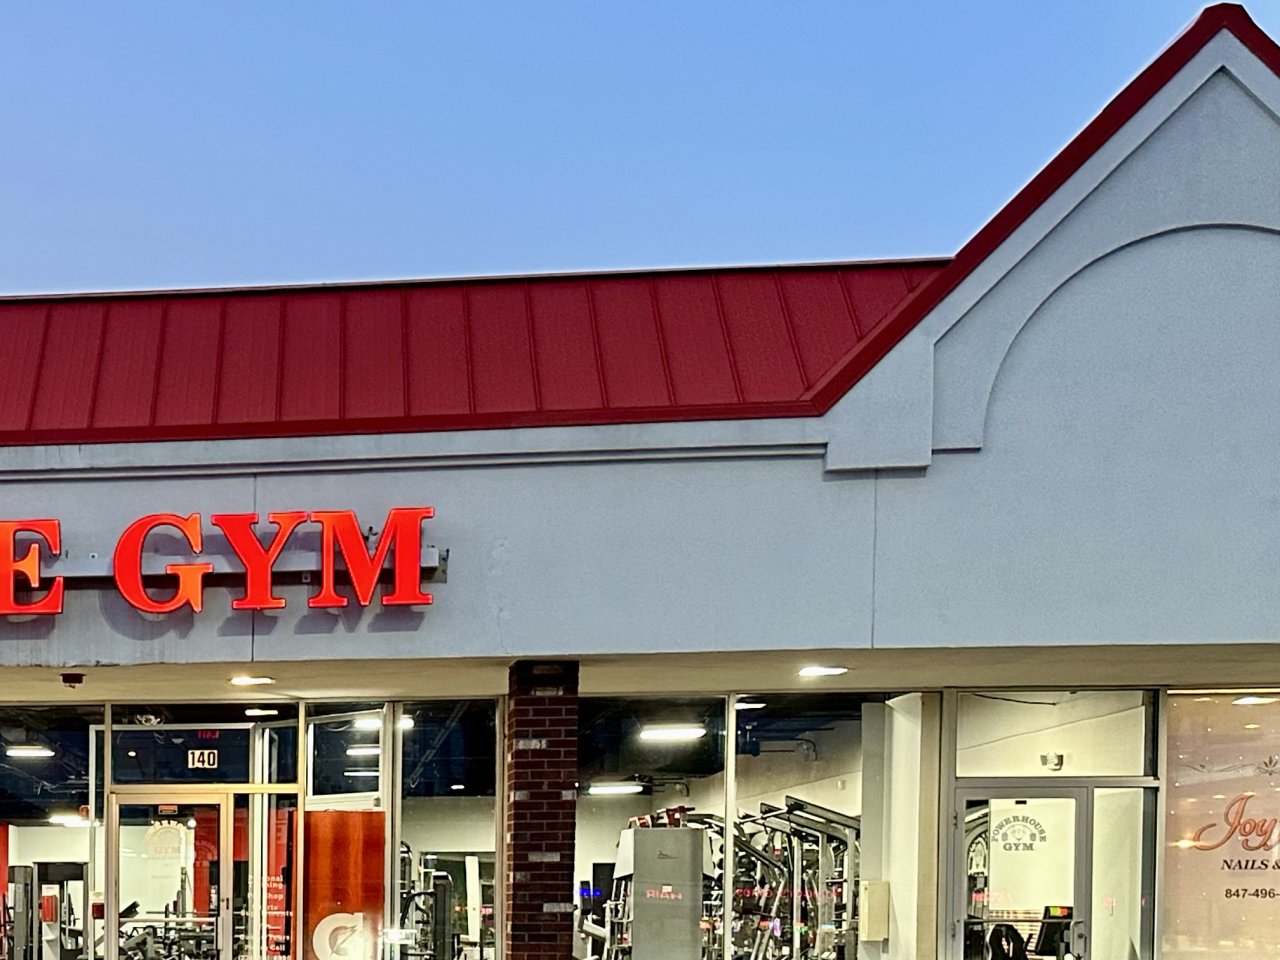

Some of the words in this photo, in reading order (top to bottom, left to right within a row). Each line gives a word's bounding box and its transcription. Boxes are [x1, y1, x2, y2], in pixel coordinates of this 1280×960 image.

[112, 507, 435, 614] GYM
[190, 751, 216, 767] 140
[992, 816, 1046, 842] POWERHOUSE
[1003, 843, 1034, 851] GYM
[1221, 860, 1269, 870] NAILS
